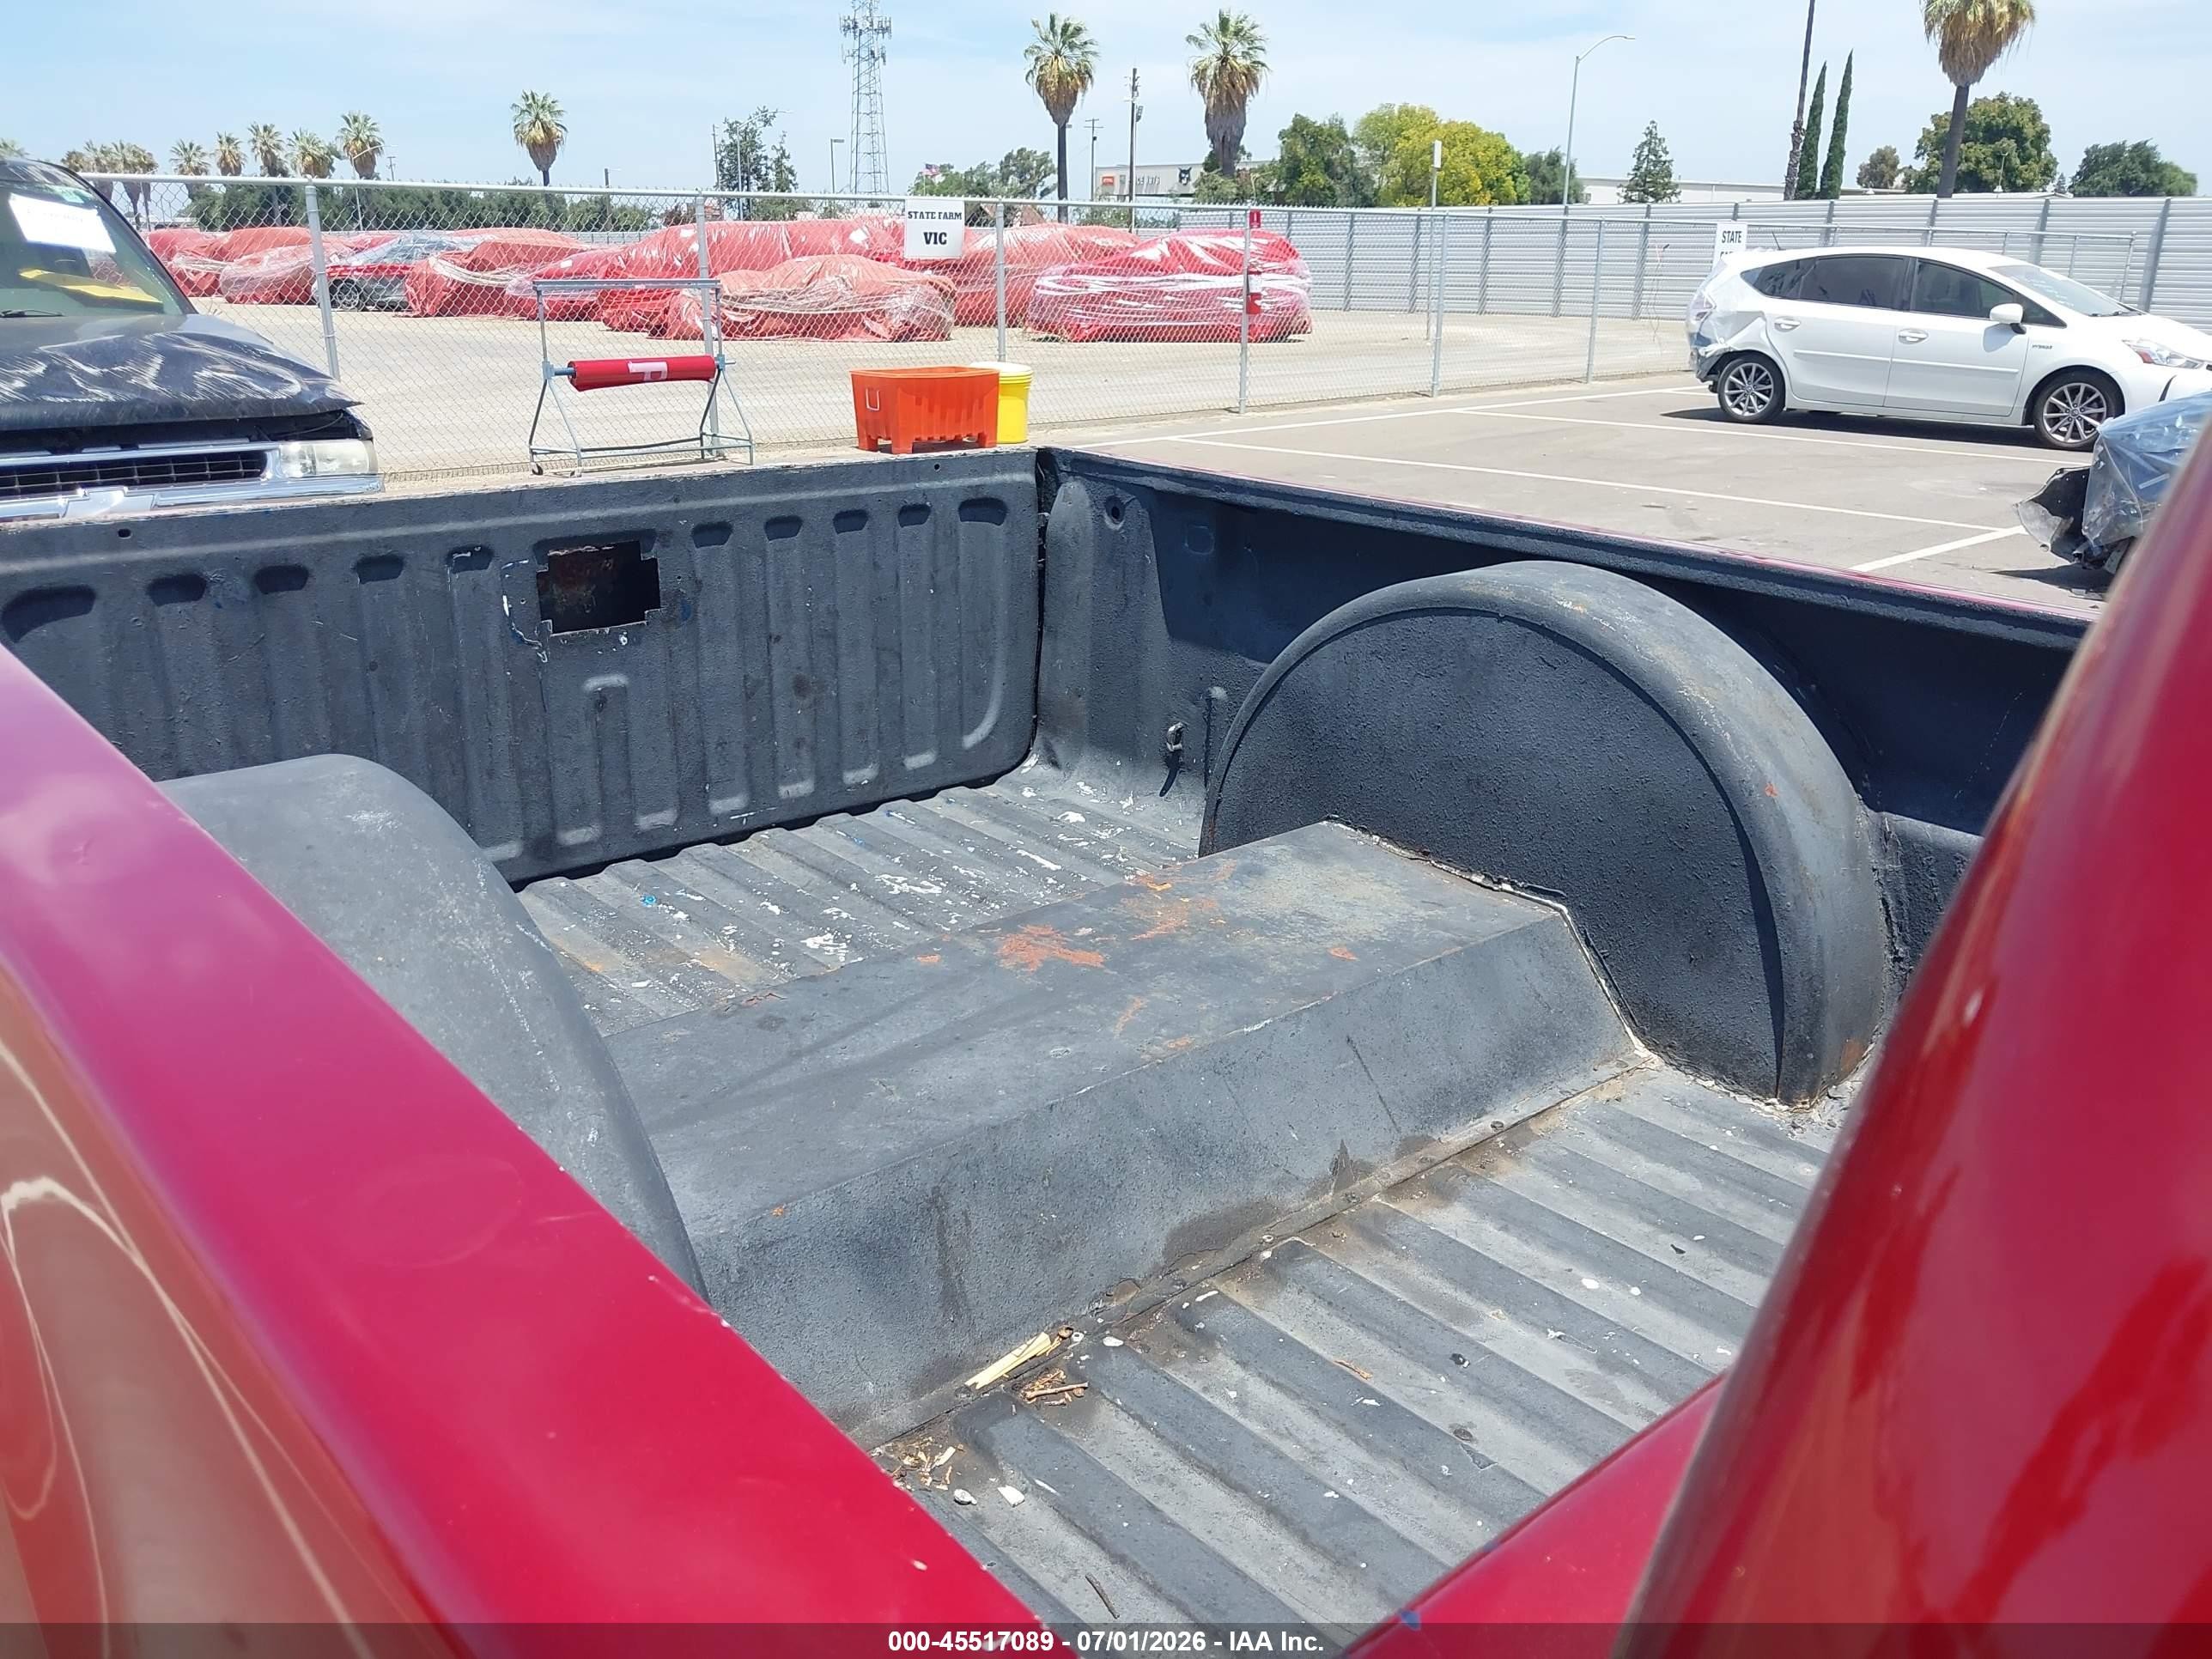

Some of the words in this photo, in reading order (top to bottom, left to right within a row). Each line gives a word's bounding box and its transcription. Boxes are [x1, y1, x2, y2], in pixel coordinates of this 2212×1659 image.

[908, 211, 936, 220] STATE
[938, 211, 963, 220] FARM
[923, 231, 947, 245] VIC
[1721, 230, 1742, 243] STATE
